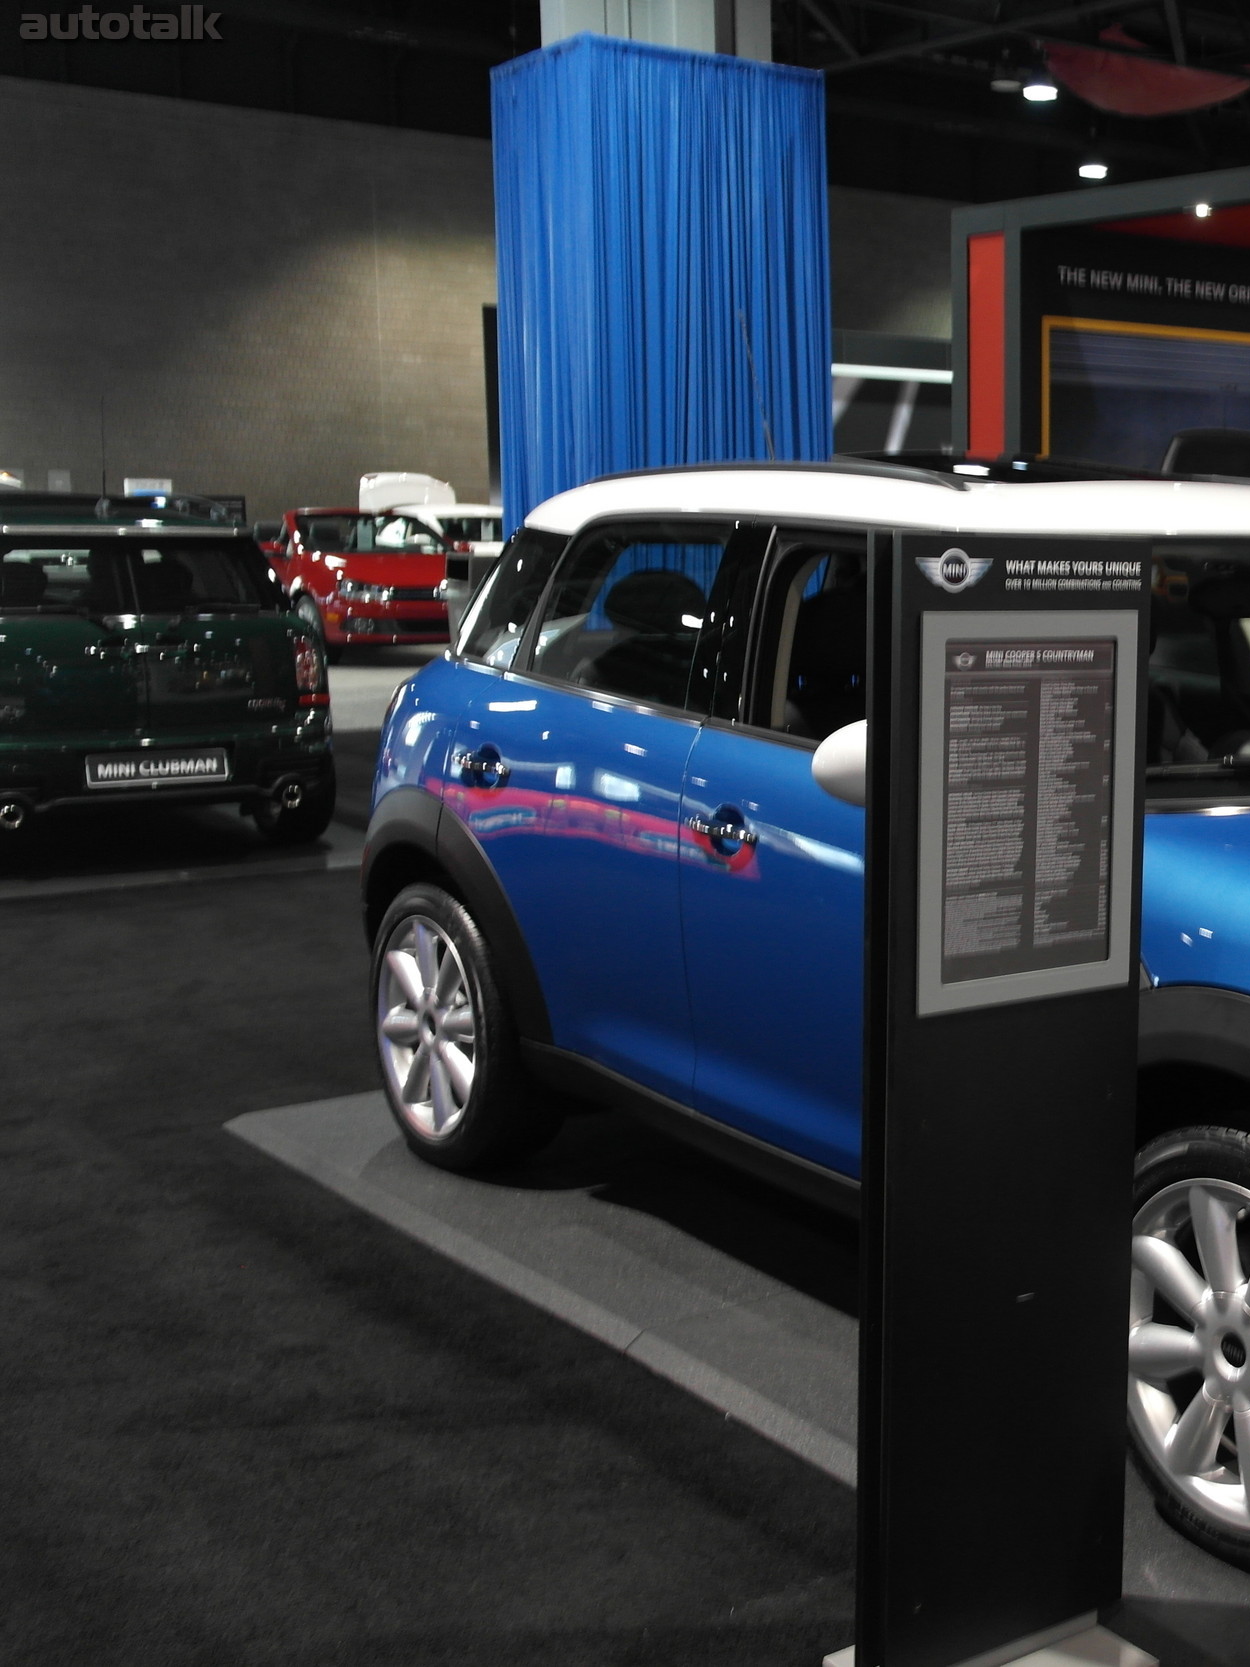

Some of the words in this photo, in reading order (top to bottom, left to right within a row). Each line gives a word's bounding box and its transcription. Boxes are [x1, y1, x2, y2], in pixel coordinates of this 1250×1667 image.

[1058, 265, 1086, 287] THE
[1090, 268, 1123, 289] NEW
[1126, 271, 1162, 296] MINI.
[1165, 276, 1192, 297] THE
[1195, 280, 1226, 301] NEW
[942, 562, 968, 579] MINI
[1005, 559, 1036, 576] WHAT
[1037, 560, 1071, 576] MAKES
[1072, 560, 1104, 577] YOURS
[1105, 561, 1141, 578] UNIQUE
[1005, 578, 1022, 591] OVER
[1023, 578, 1031, 591] 10
[1032, 578, 1057, 591] MILLION
[1058, 579, 1101, 591] COMBINATIONS
[1112, 579, 1141, 592] COUNTING
[985, 650, 1004, 661] MINI
[1005, 650, 1035, 661] COOPER
[1042, 649, 1094, 662] COUNTRYMAN
[97, 761, 136, 779] MINI
[138, 757, 218, 777] CLUBMAN
